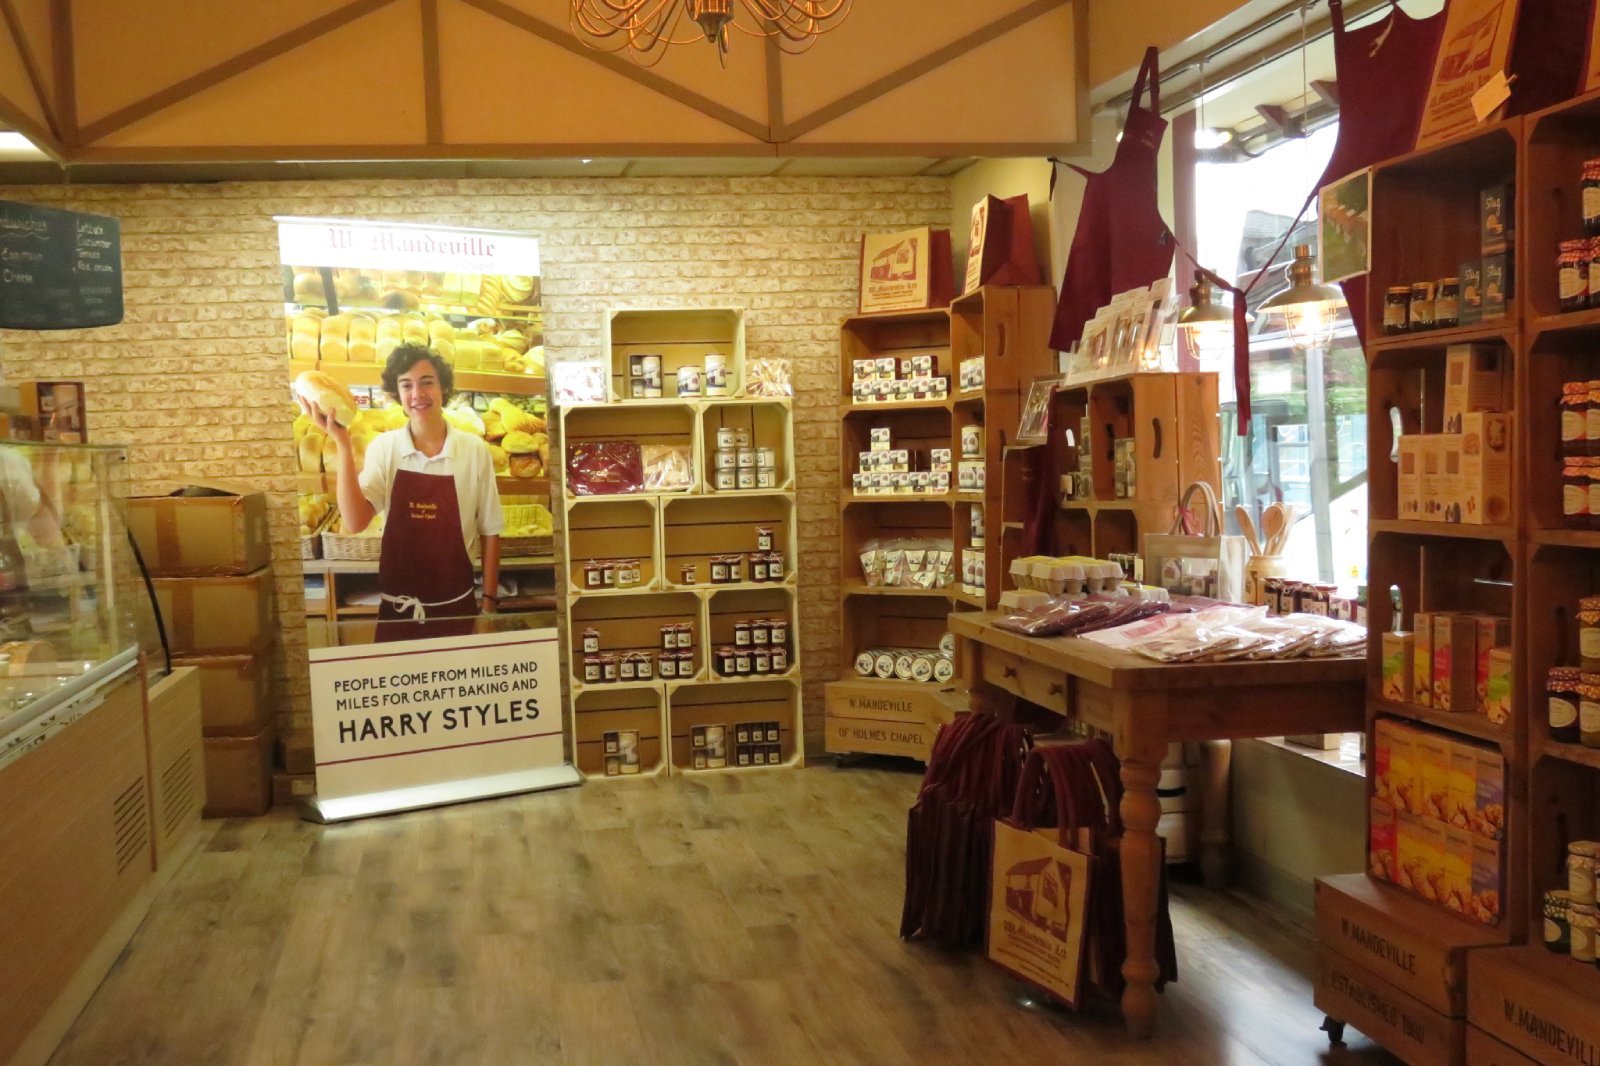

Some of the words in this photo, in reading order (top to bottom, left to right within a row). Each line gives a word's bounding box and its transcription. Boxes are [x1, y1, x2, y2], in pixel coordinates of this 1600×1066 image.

[370, 231, 496, 257] Mandeville
[334, 676, 387, 693] PEOPLE
[390, 672, 429, 687] COME
[431, 668, 467, 683] FROM
[471, 664, 509, 679] MILES
[511, 661, 538, 674] AND
[336, 695, 379, 711] MILES
[382, 692, 410, 706] FOR
[413, 687, 455, 703] CRAFT
[459, 681, 509, 698] BAKING
[512, 678, 538, 691] AND
[338, 710, 433, 743] HARRY
[442, 698, 540, 730] STYLES
[838, 727, 849, 737] OF
[853, 728, 887, 741] HOLMES
[890, 732, 925, 745] CHAPEL
[1330, 971, 1397, 1027] ESTABLISHED
